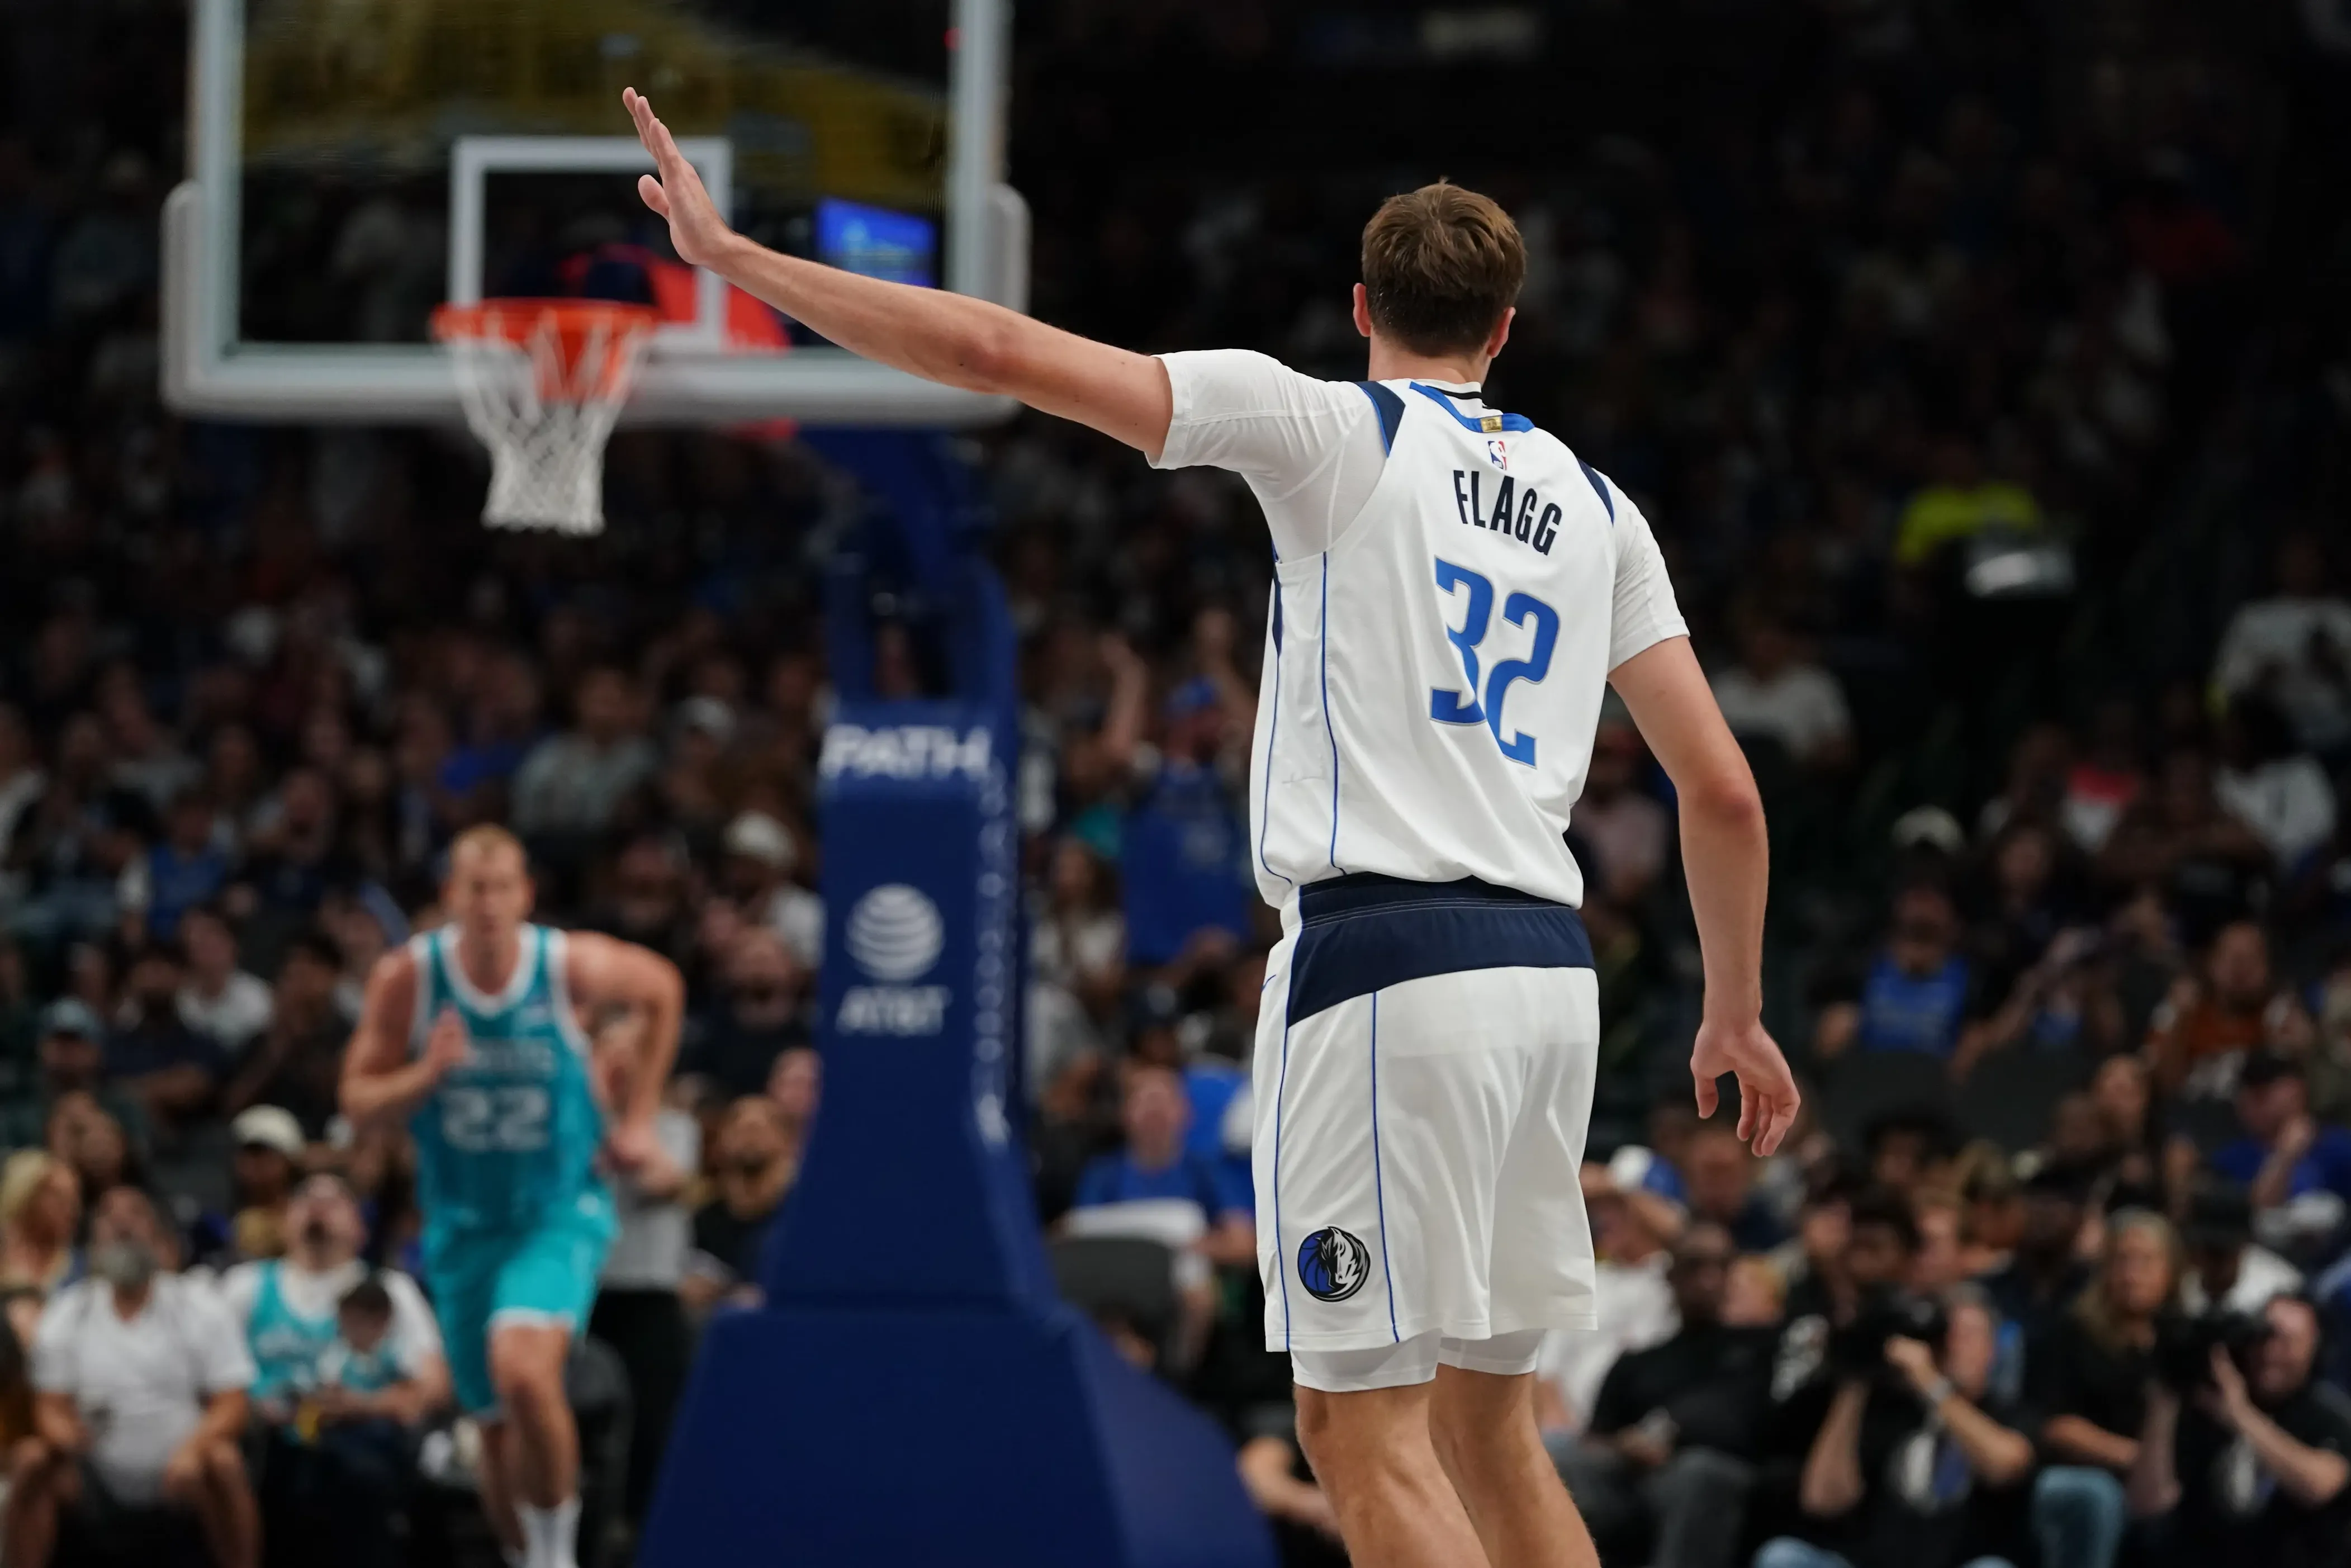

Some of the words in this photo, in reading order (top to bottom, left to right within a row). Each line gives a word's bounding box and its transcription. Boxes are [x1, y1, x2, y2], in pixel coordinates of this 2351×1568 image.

[1453, 469, 1563, 556] FLAGG
[1429, 555, 1561, 769] 32
[837, 985, 952, 1035] AT&T
[443, 1086, 549, 1150] 22
